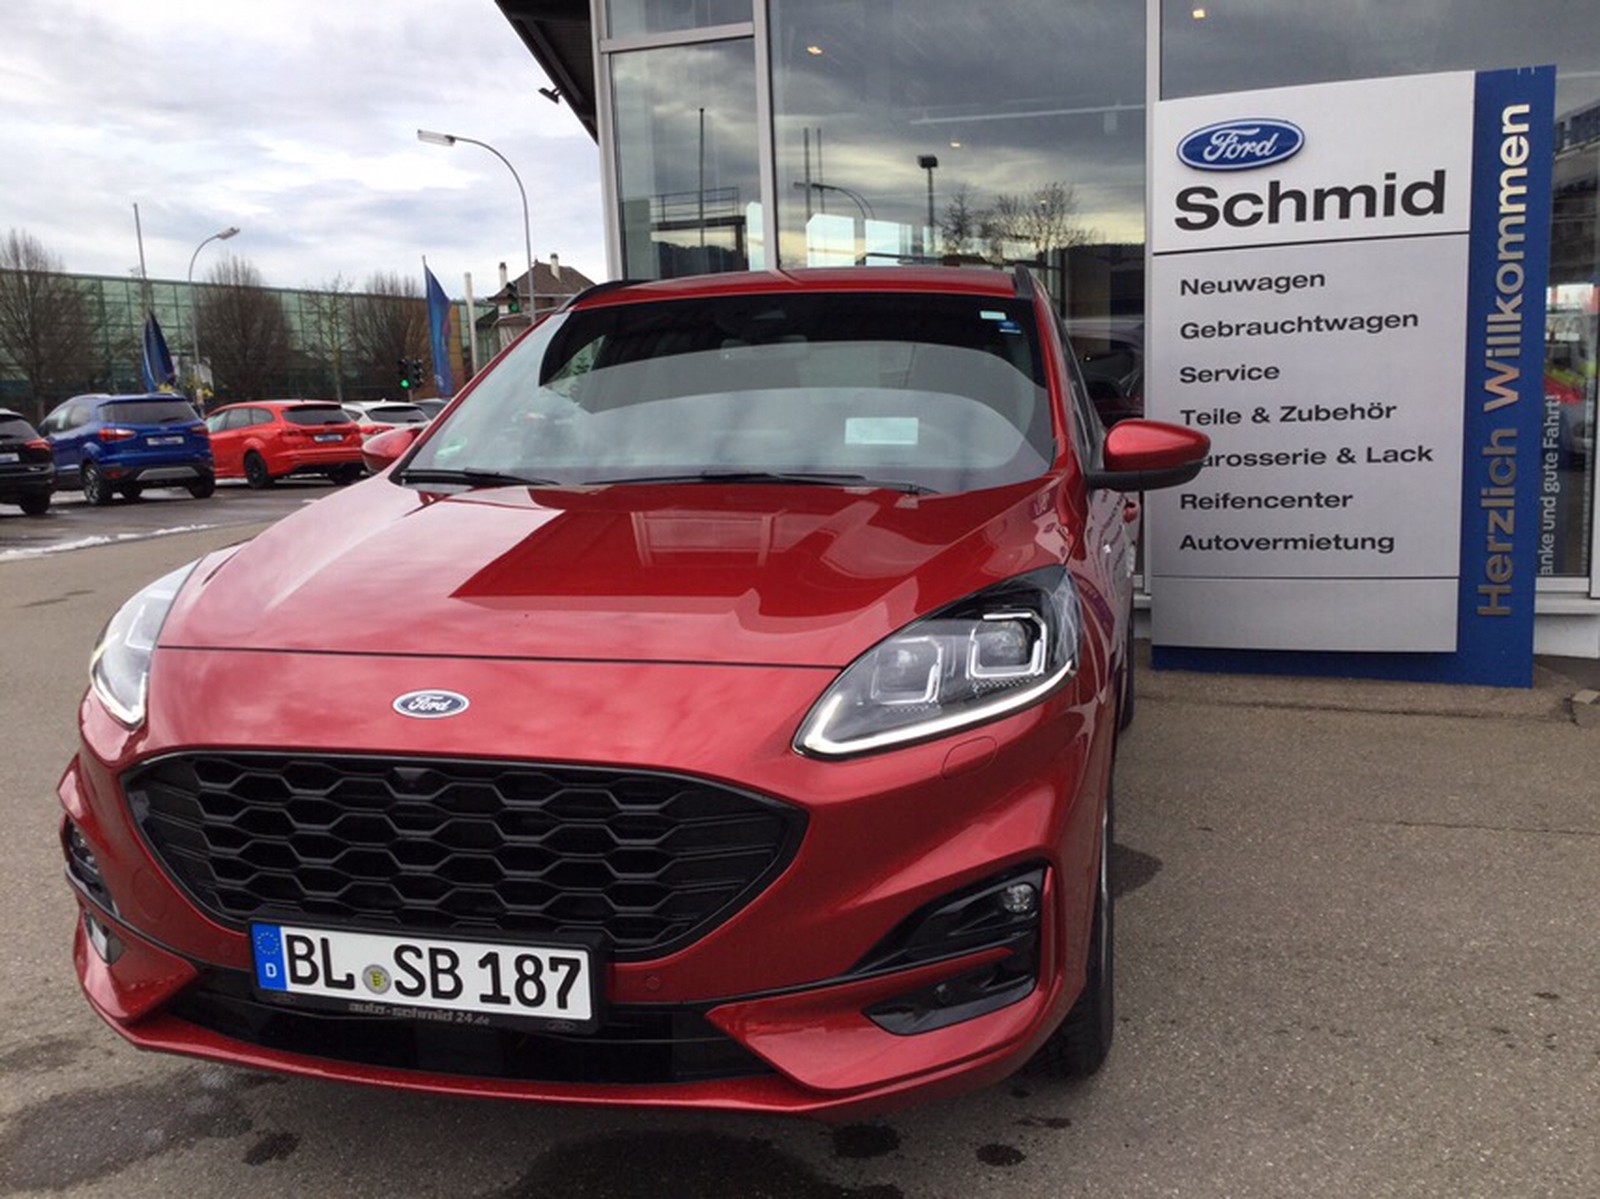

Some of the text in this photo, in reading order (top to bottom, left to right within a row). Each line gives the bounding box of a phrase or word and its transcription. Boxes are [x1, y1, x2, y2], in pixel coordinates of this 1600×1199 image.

[1203, 127, 1280, 161] Ford
[1174, 169, 1446, 231] Schmid
[1180, 273, 1326, 296] Neuwagen
[1179, 313, 1419, 340] Gebrauchtwagen
[1477, 103, 1530, 617] Herzlich Willkommen
[1179, 364, 1280, 384] Service
[1180, 402, 1397, 426] Teile & Zubehör
[1200, 445, 1434, 467] arosserie & Lack
[1543, 452, 1561, 494] gute
[1180, 491, 1353, 510] Reifencenter
[1540, 496, 1557, 531] und
[1179, 533, 1395, 554] Autovermietung
[1538, 533, 1555, 576] anke
[265, 963, 278, 978] D
[285, 933, 582, 1010] BL SB 187
